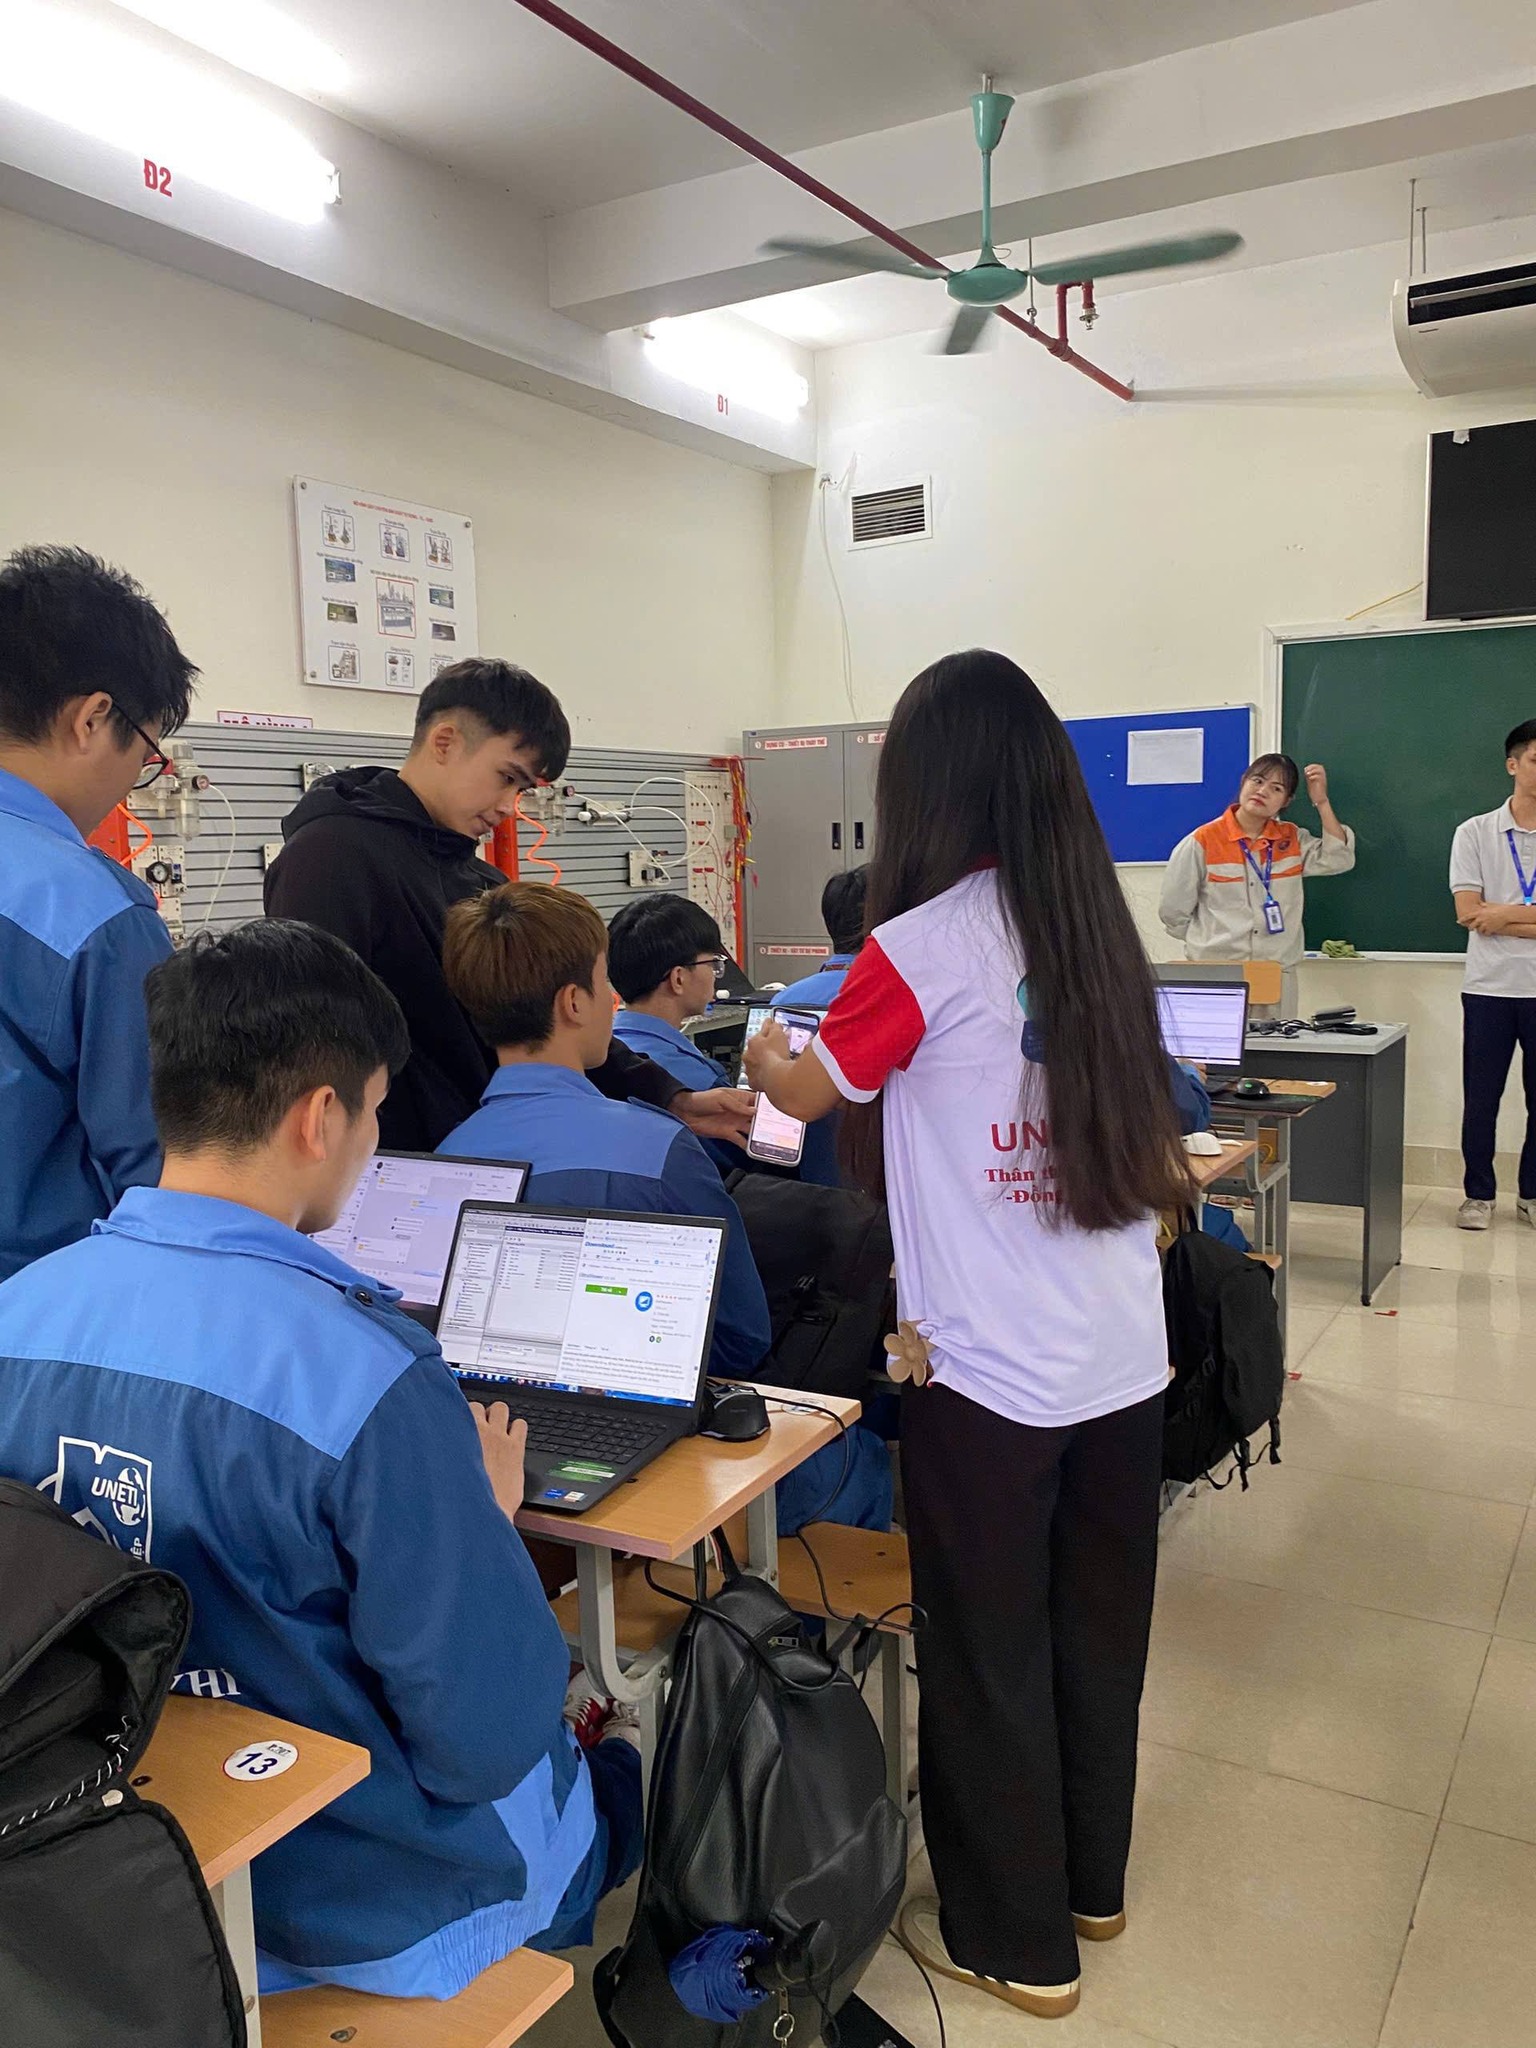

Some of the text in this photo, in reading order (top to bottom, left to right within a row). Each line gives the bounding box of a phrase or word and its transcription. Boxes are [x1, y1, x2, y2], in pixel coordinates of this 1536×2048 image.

[144, 158, 172, 197] Đ2
[991, 1119, 1048, 1152] UN
[984, 1167, 1035, 1182] Thân
[91, 1477, 138, 1507] UNETI
[236, 1752, 278, 1775] 13
